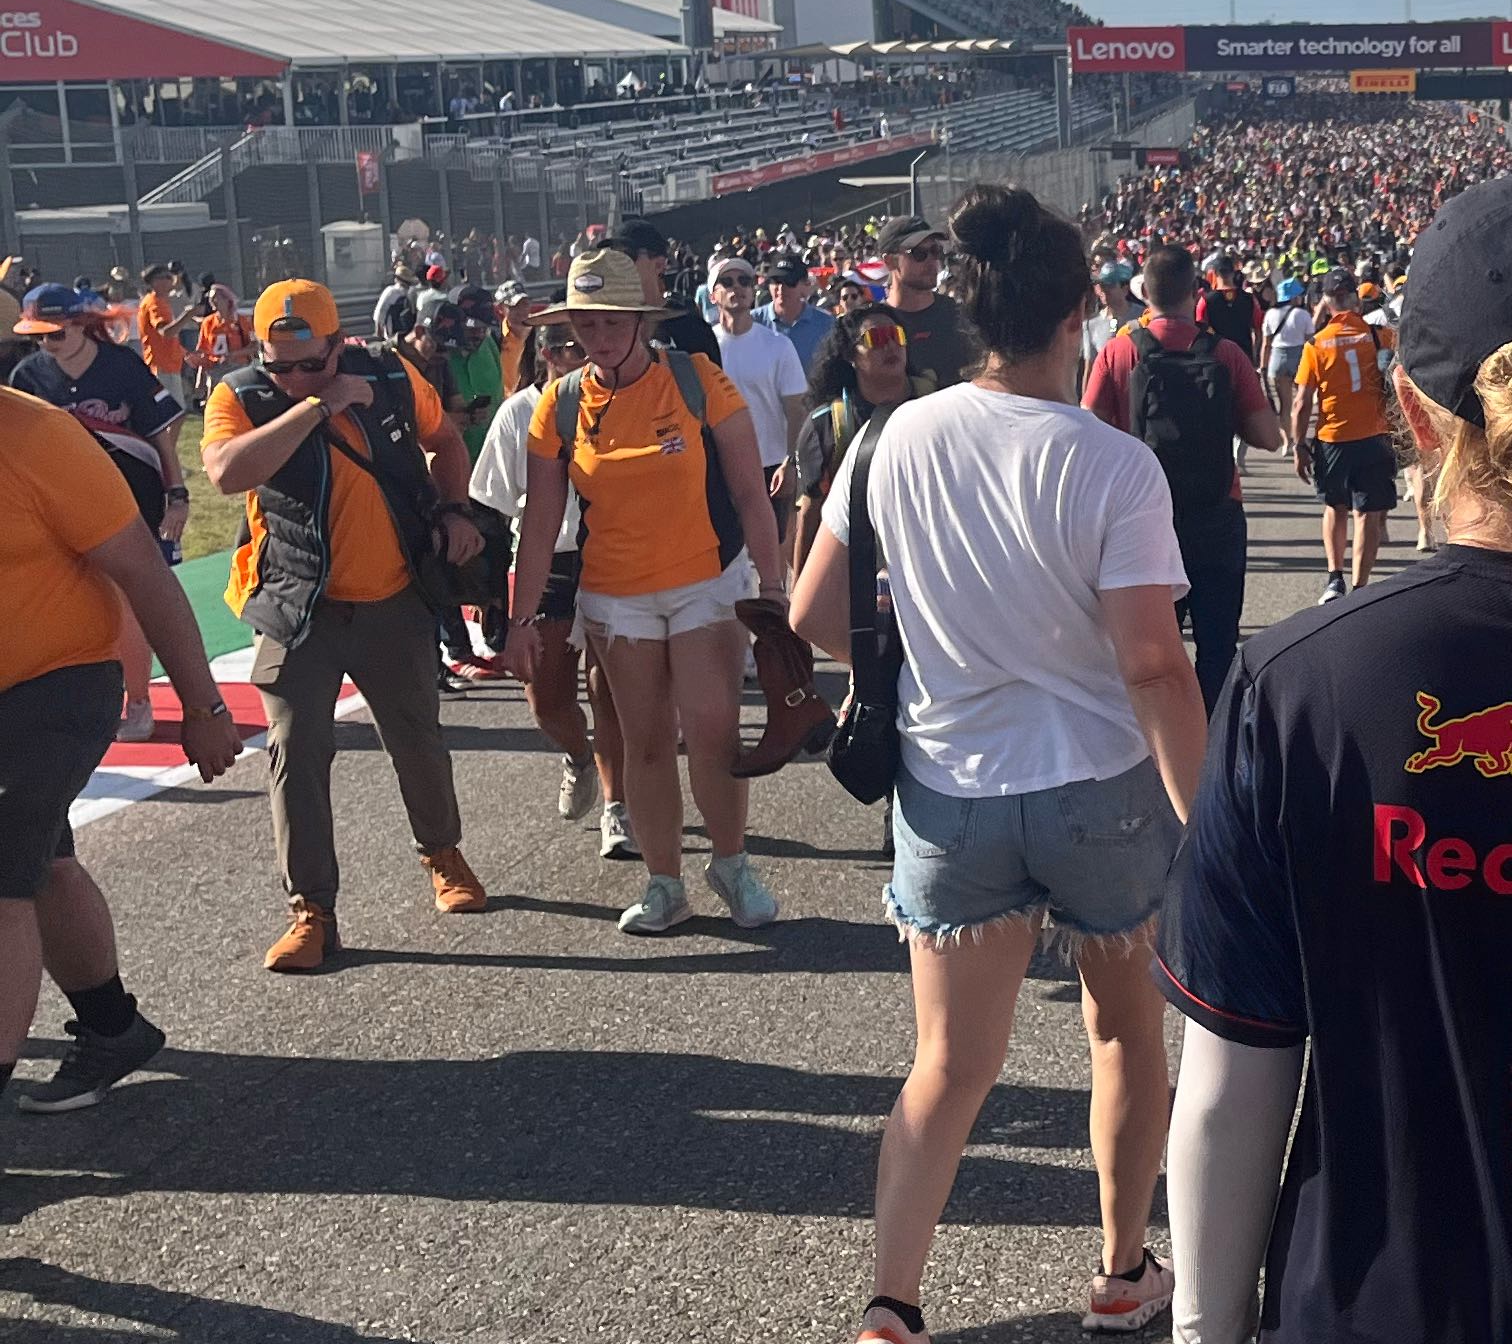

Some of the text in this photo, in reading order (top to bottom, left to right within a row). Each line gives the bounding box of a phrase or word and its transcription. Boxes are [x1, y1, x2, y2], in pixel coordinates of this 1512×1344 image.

[1, 30, 79, 57] Club
[1076, 37, 1175, 61] Lenovo
[1217, 35, 1461, 58] Smarter technology for all
[1267, 81, 1291, 94] FIA
[213, 333, 229, 355] 4
[1344, 348, 1361, 393] 1
